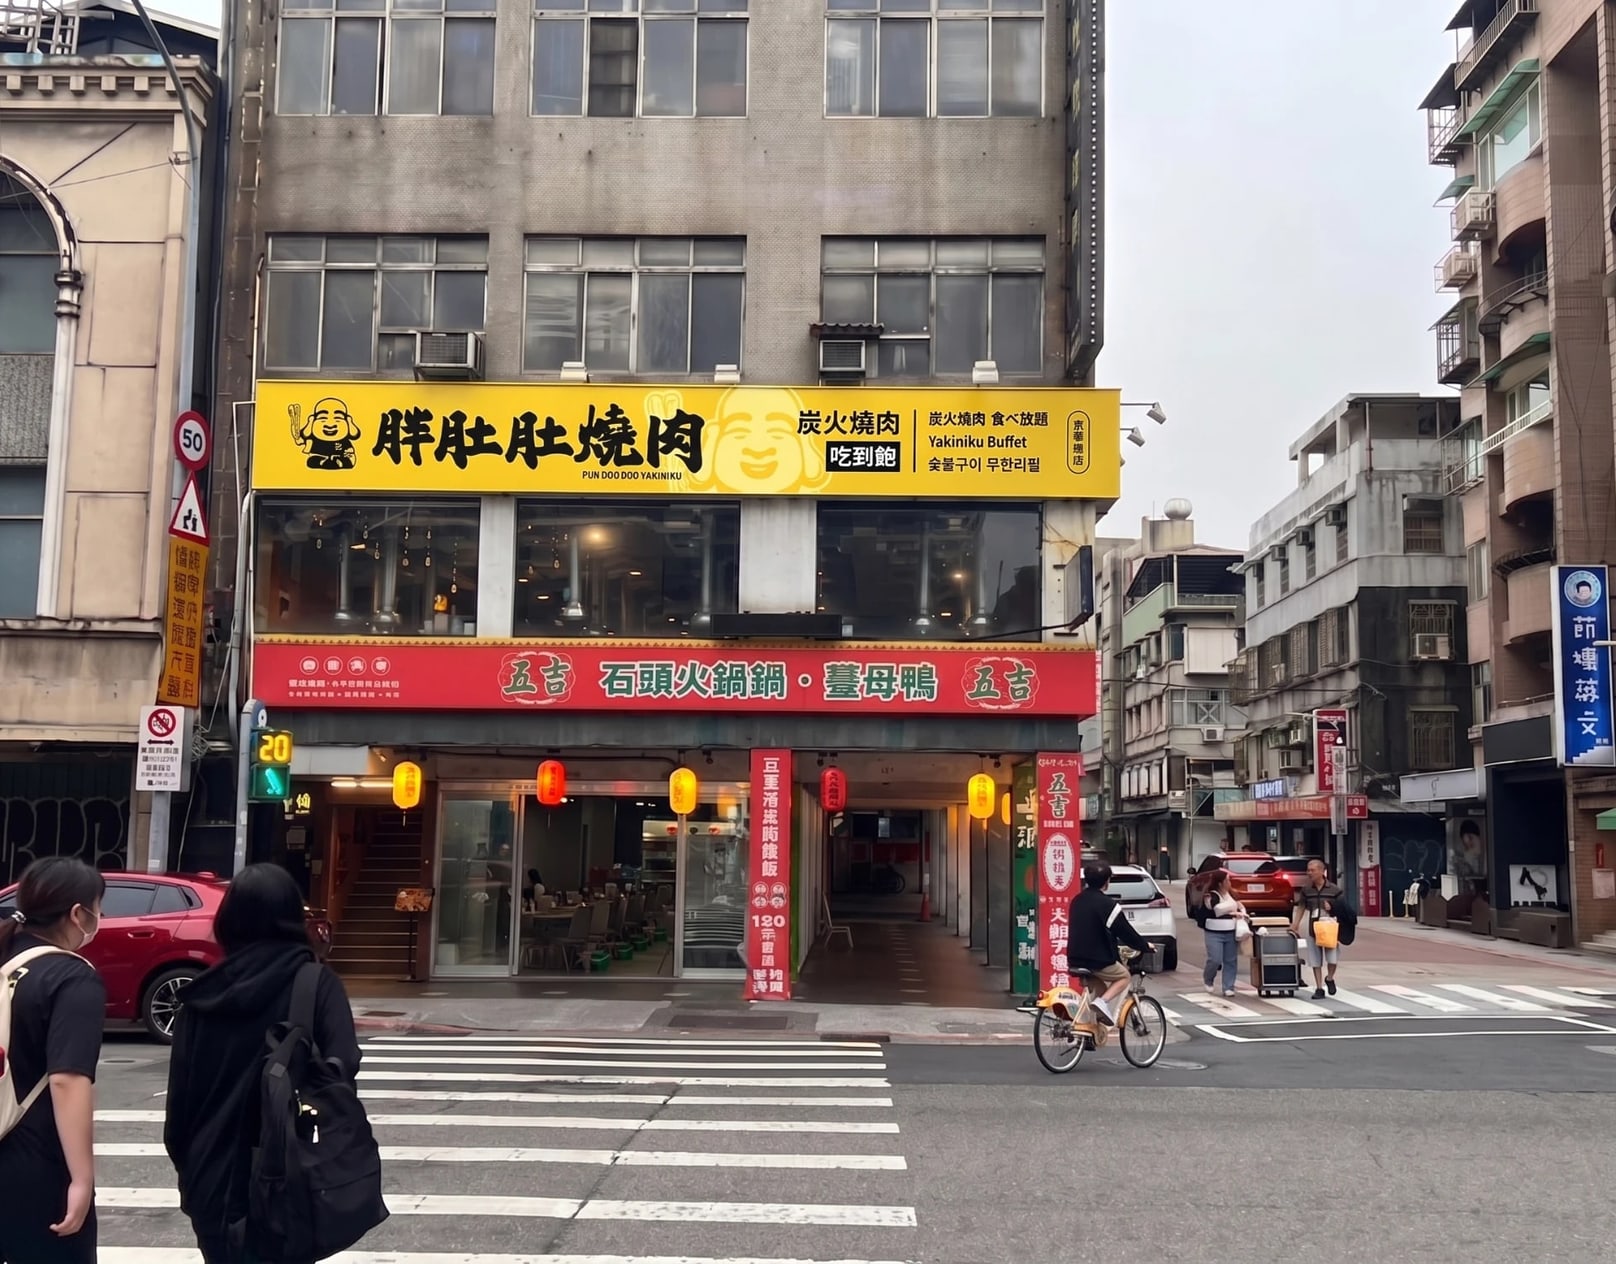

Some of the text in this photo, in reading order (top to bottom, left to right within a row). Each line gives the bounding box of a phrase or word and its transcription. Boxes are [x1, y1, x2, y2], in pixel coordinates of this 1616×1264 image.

[797, 410, 900, 436] 炭火燒肉
[929, 411, 1049, 427] 炭火燒肉 食べ放題
[182, 428, 203, 452] 50
[372, 404, 705, 473] 胖肚肚燒肉
[929, 435, 1027, 448] Yakiniku Buffet
[829, 445, 897, 468] 吃到飽
[928, 457, 1040, 472] 숯불구이 무한리필
[582, 471, 682, 480] PUN DOO DOO YAKINIKU
[503, 656, 573, 695] 五吉
[966, 662, 1036, 703] 五吉
[259, 734, 290, 762] 20
[752, 915, 786, 928] 120
